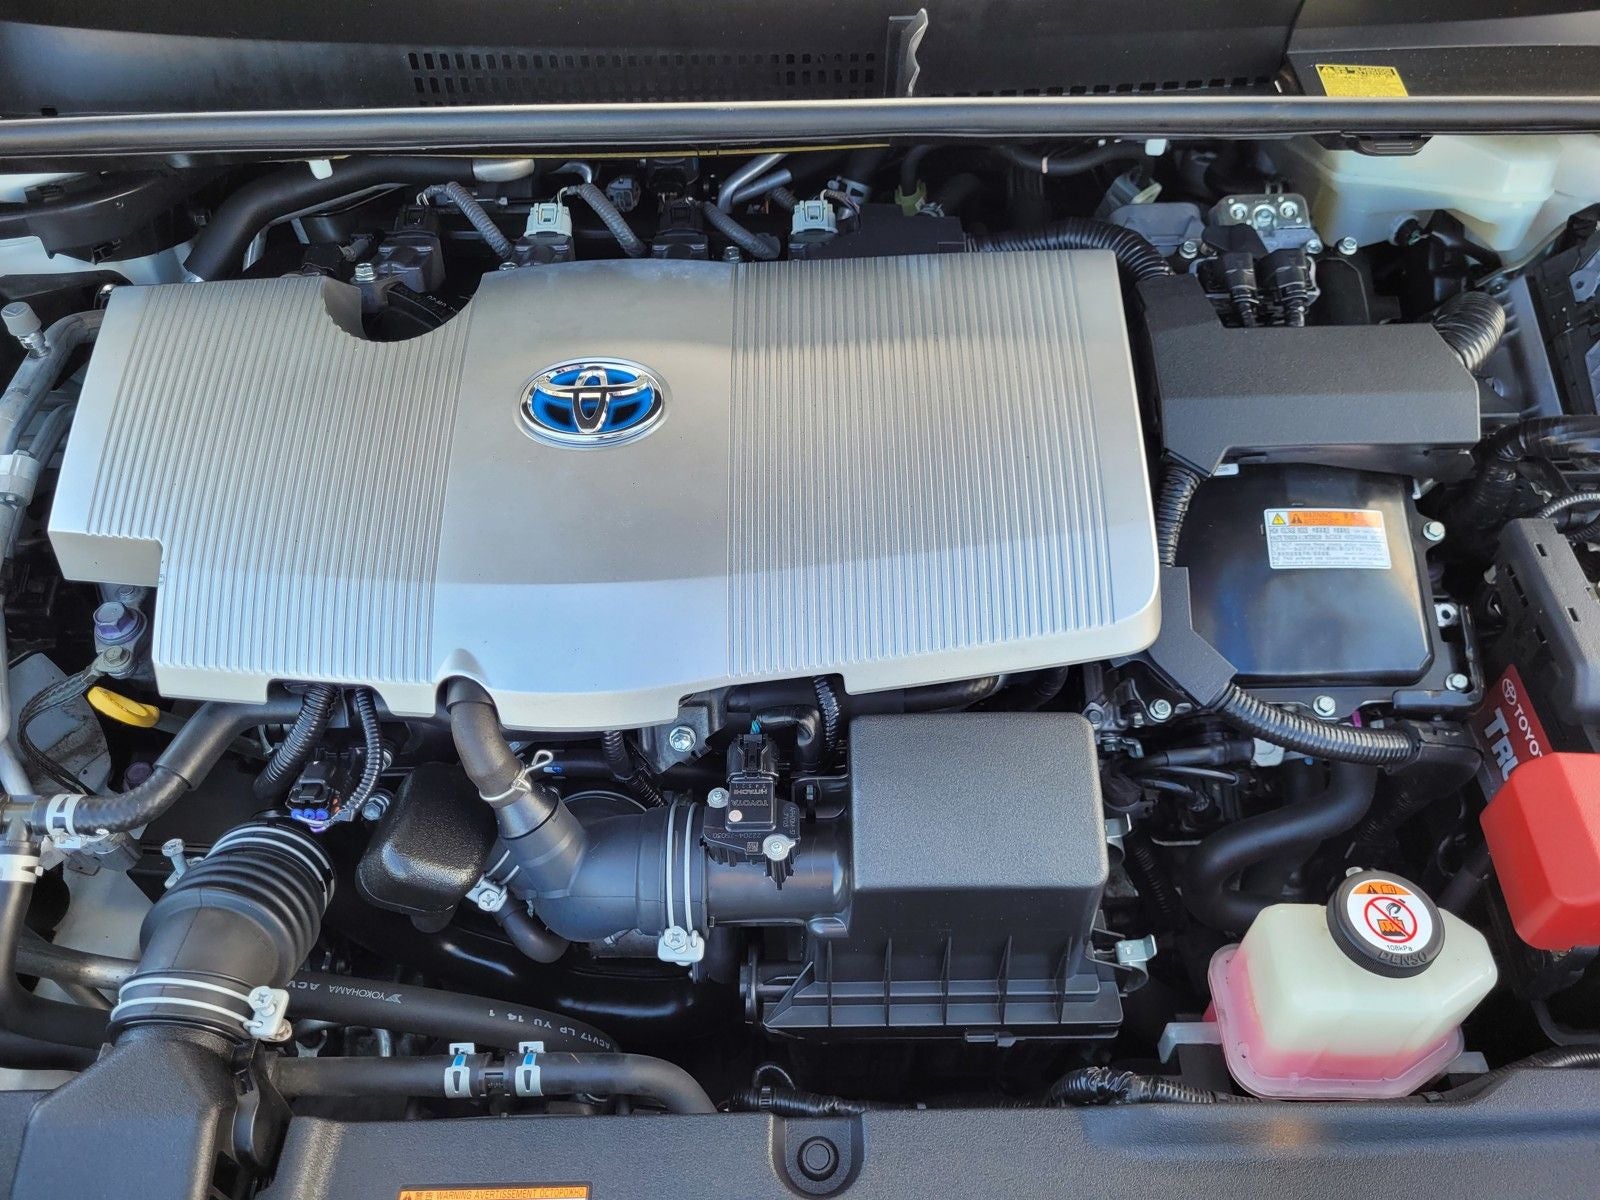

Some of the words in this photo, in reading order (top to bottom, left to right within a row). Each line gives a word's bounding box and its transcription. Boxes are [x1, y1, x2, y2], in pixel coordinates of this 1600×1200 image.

[1514, 703, 1543, 757] TOYO
[1379, 950, 1427, 966] DENSO
[328, 984, 386, 1001] YOKOHAMA
[507, 1012, 524, 1023] 14
[533, 1018, 552, 1029] YU
[559, 1026, 576, 1036] LP
[580, 1032, 611, 1049] ACV17
[436, 1190, 472, 1200] WARNING
[474, 1188, 537, 1199] AVERTISSEMENT
